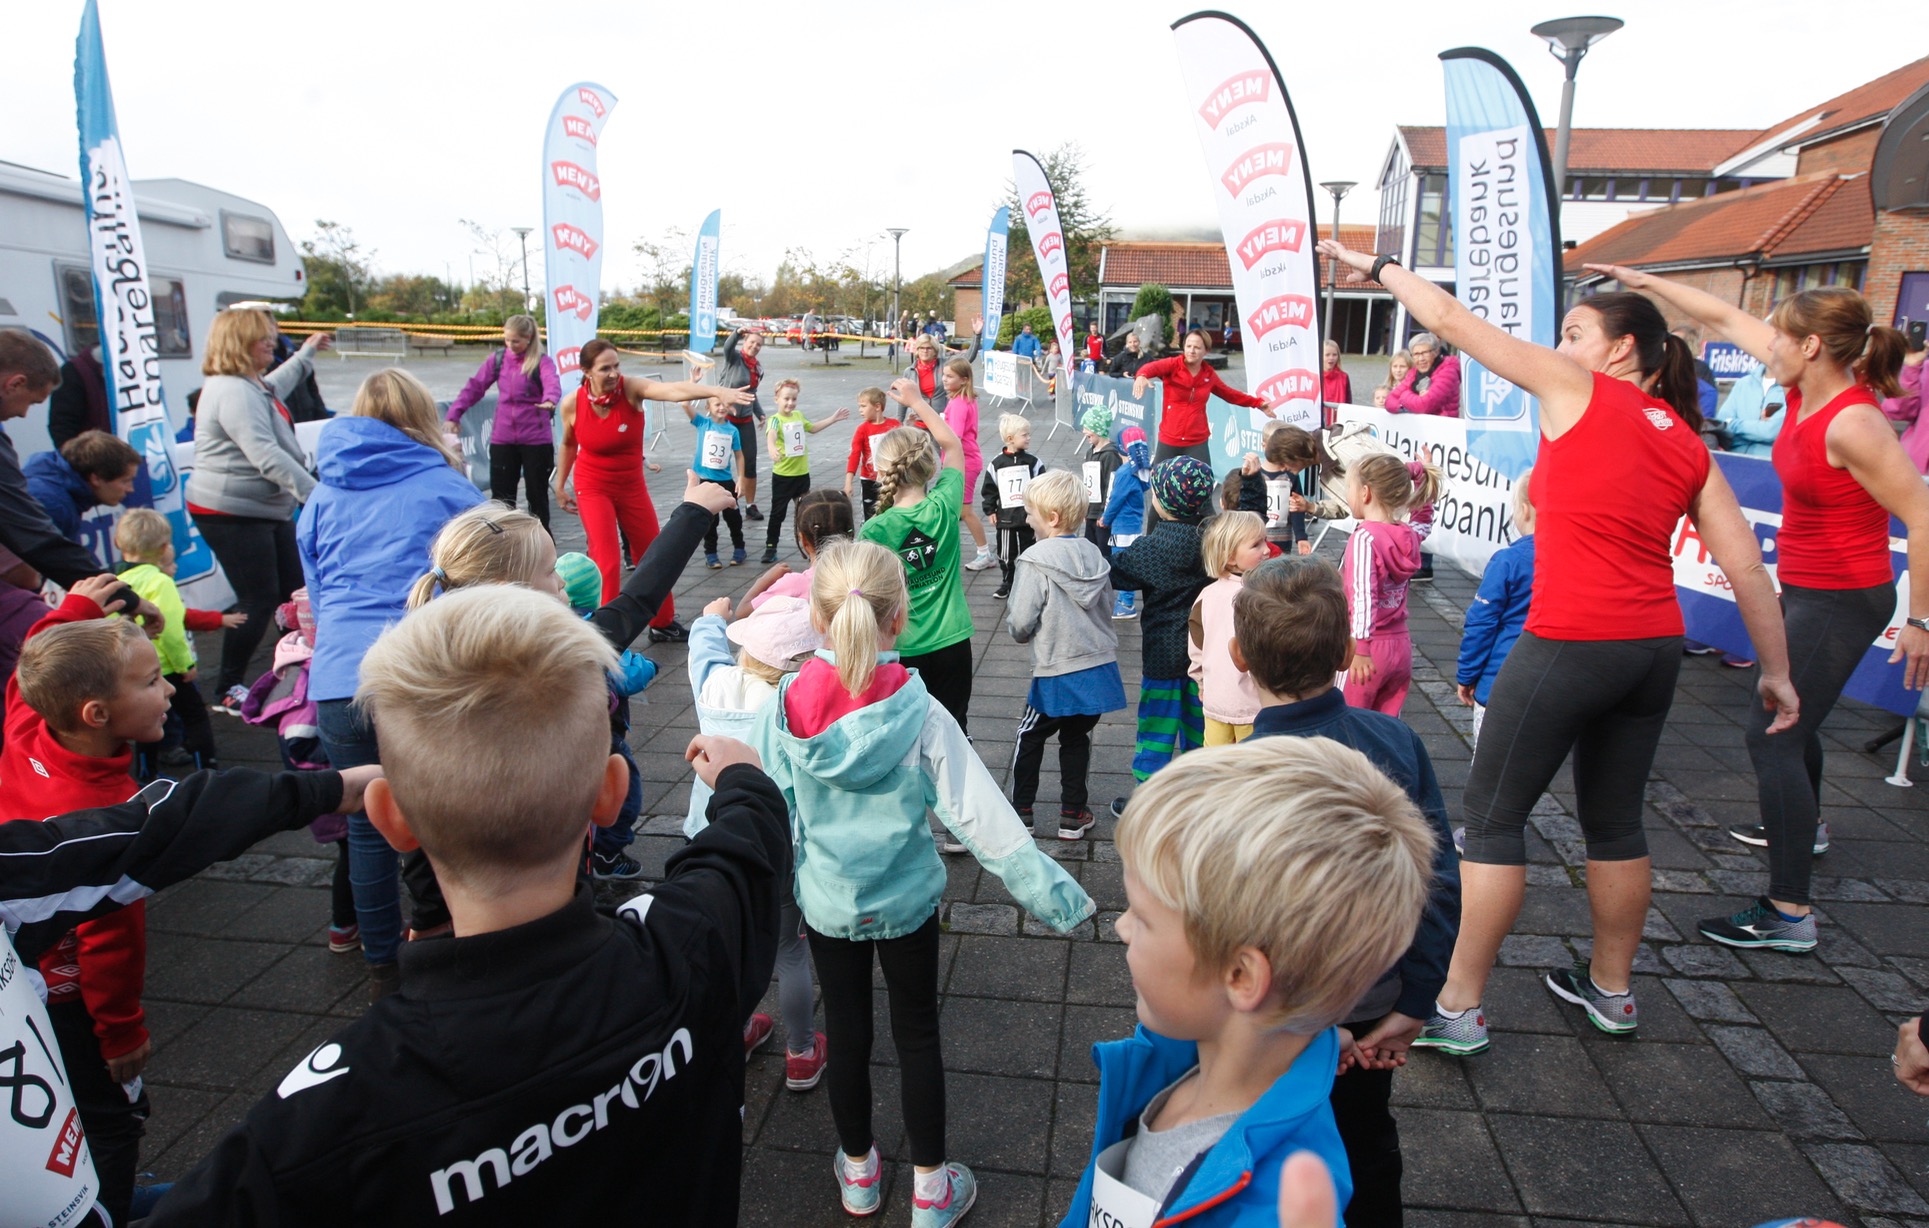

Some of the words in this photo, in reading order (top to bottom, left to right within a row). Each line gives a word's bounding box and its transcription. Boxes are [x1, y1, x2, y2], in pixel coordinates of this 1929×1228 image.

[555, 165, 600, 193] MENY
[794, 431, 801, 445] 9
[708, 444, 726, 458] 23
[1008, 478, 1023, 493] 77
[429, 1027, 694, 1216] macron
[48, 1184, 89, 1228] STEINSVIK
